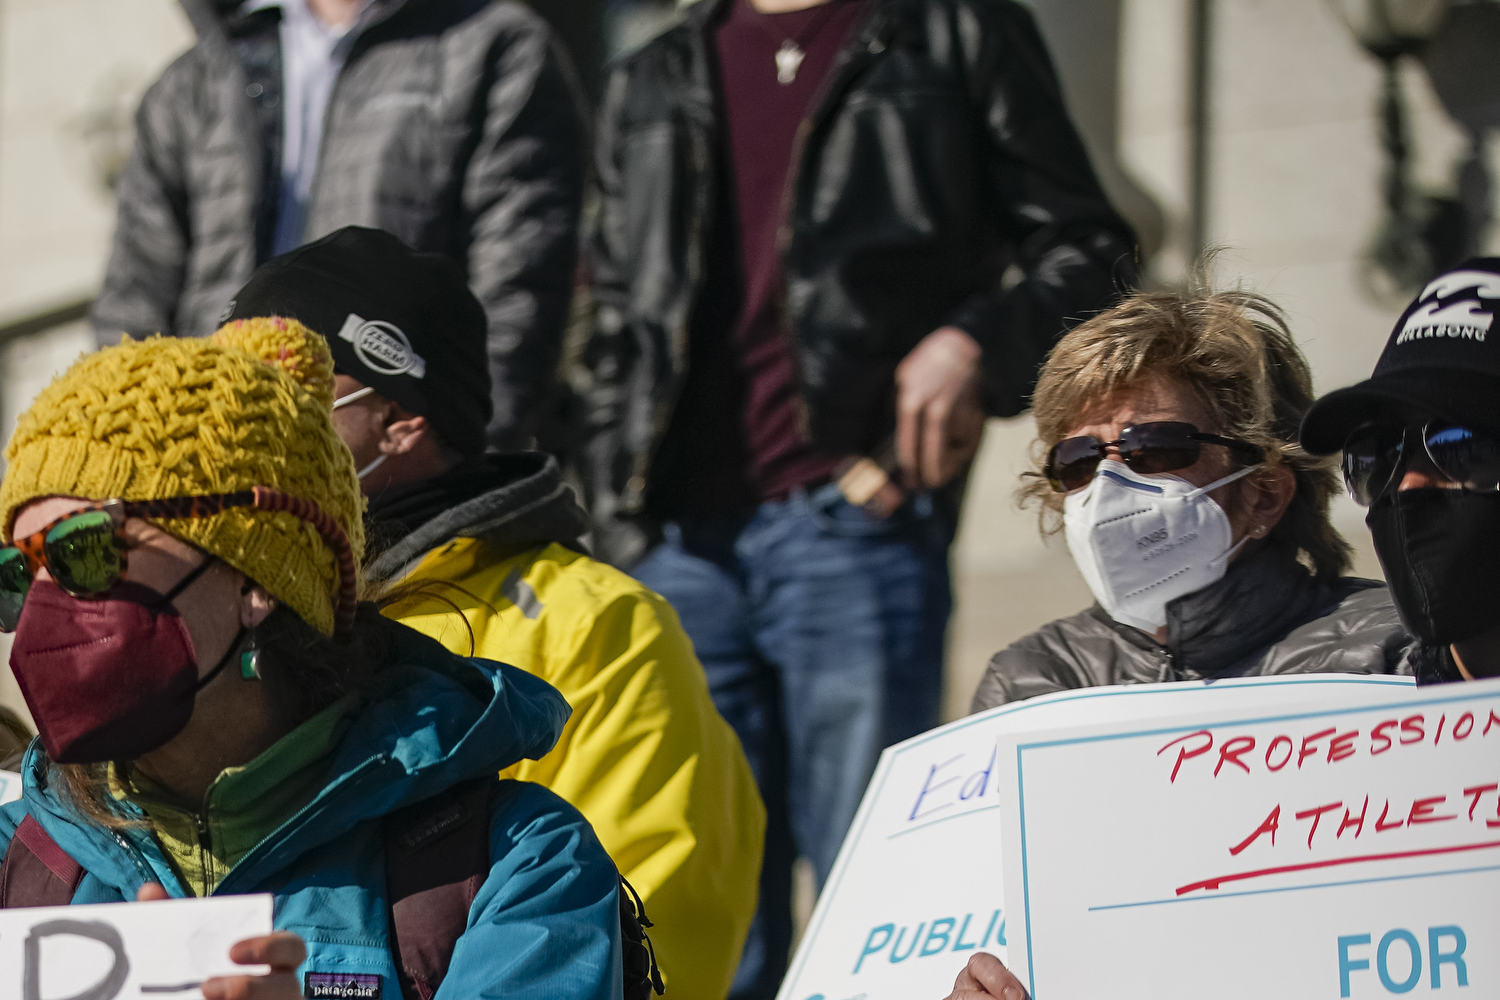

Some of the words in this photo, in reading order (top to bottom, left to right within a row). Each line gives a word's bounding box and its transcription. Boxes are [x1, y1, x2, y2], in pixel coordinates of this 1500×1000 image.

[1135, 527, 1169, 550] KN95
[908, 743, 1000, 821] Ed
[1337, 925, 1470, 998] FOR
